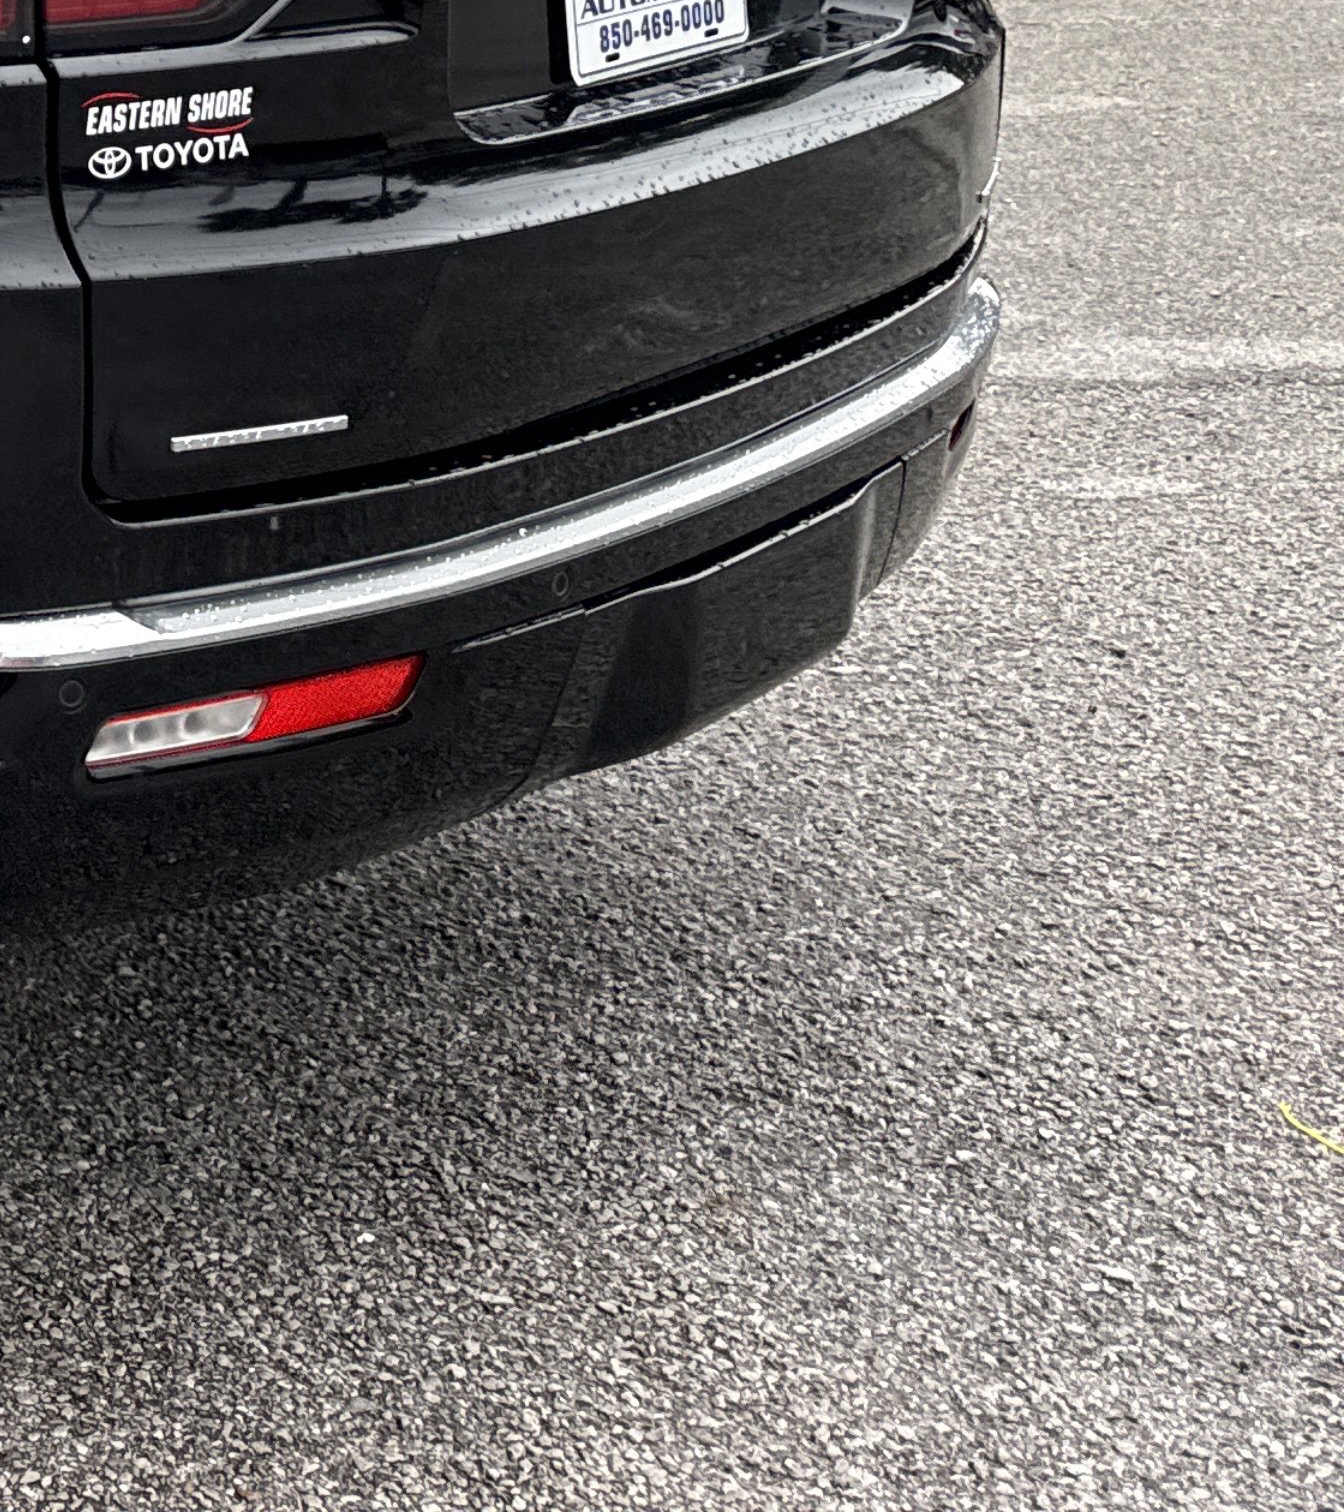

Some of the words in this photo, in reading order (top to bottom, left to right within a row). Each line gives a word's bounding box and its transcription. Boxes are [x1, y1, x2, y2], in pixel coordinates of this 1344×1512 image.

[86, 97, 182, 136] EASTERN
[187, 86, 253, 122] SHORE
[135, 133, 249, 171] TOYOTA
